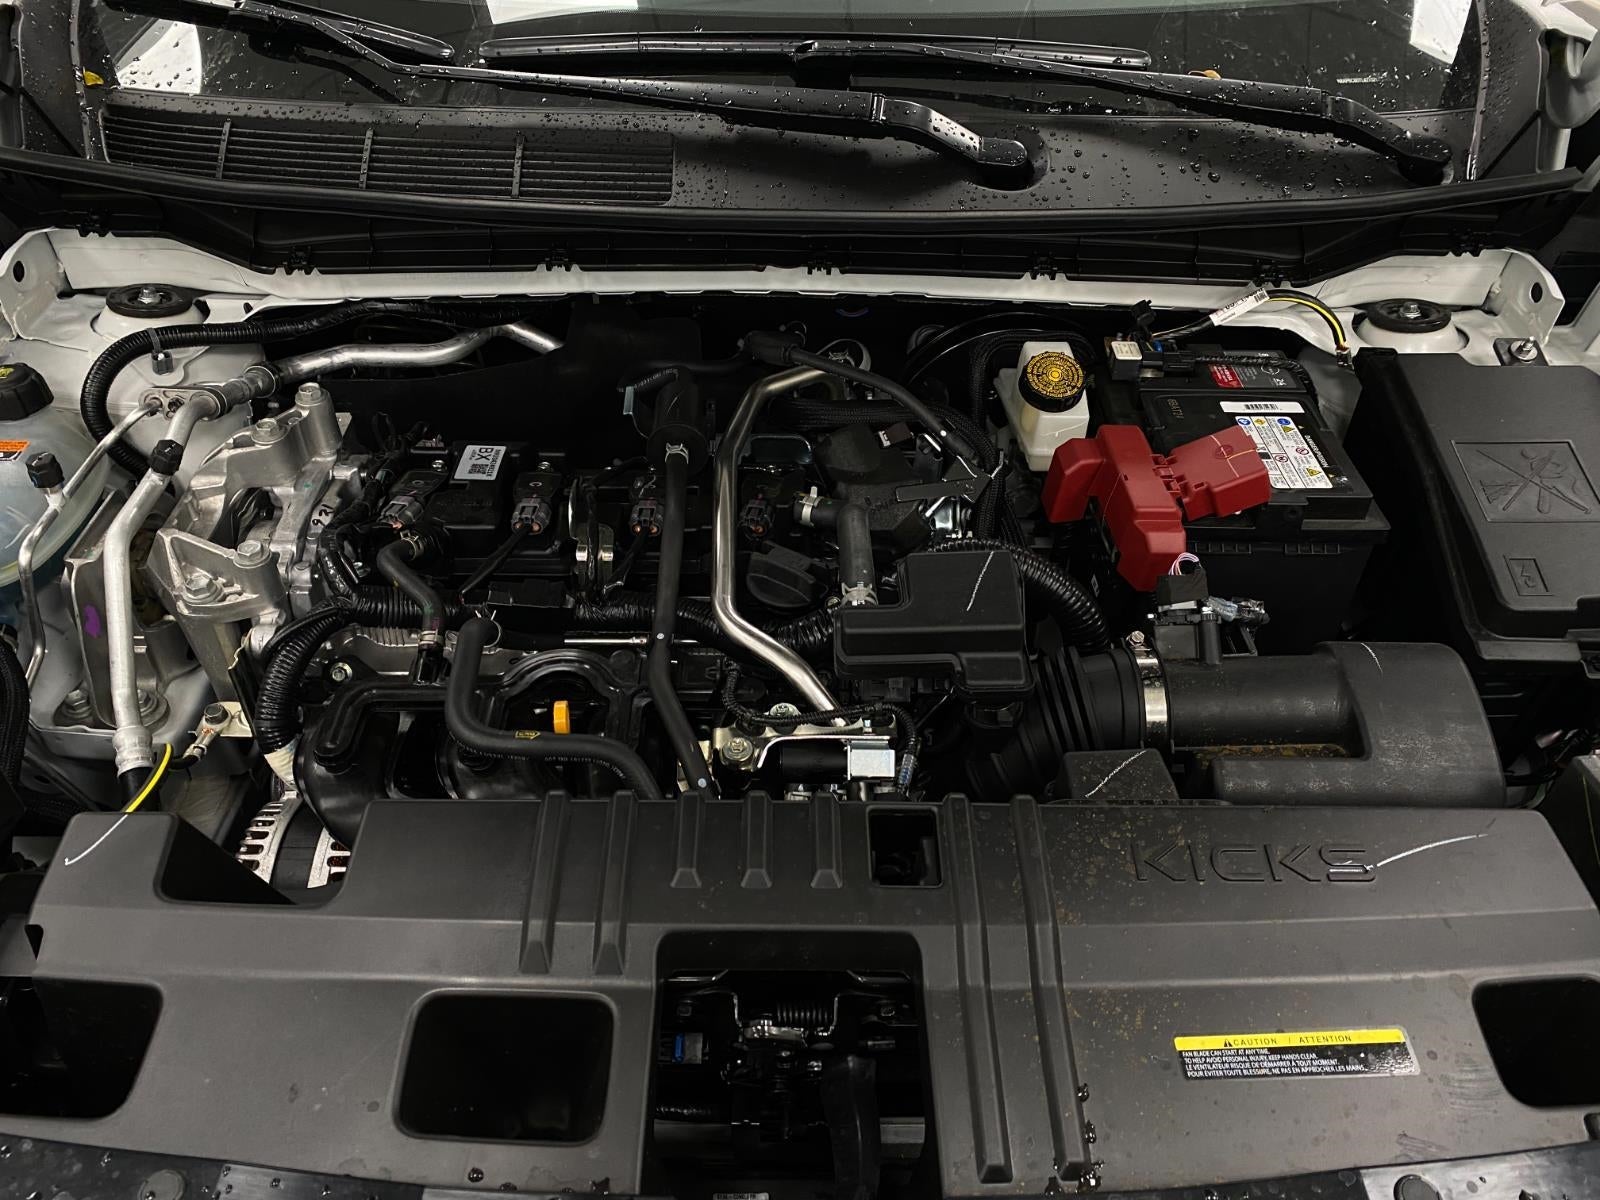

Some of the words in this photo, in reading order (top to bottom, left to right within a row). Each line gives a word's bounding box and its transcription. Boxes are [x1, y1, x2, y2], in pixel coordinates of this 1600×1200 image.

[474, 448, 494, 460] BX
[1130, 842, 1376, 882] KICKS
[1234, 1038, 1277, 1046] CAUTION
[1300, 1034, 1352, 1044] ATTENTION
